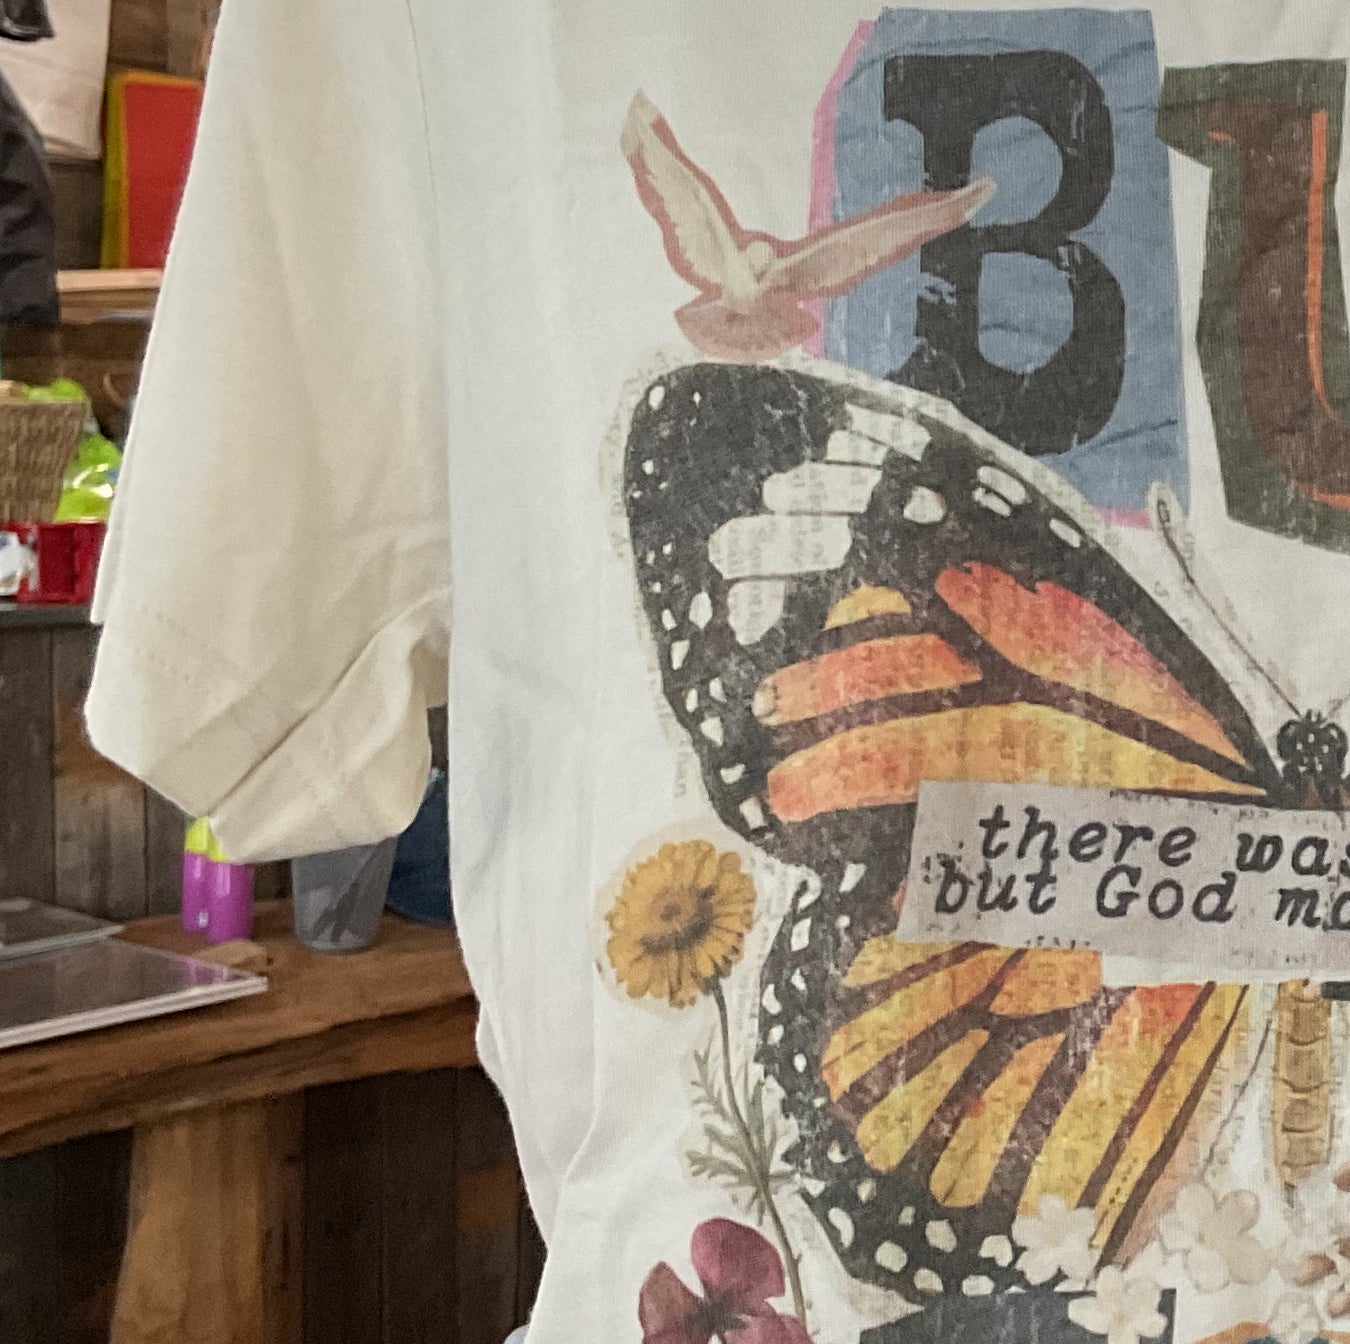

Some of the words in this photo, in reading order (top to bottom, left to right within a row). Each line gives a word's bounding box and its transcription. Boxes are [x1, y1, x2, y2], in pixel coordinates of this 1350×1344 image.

[978, 804, 1198, 867] there
[935, 855, 1057, 915] but
[1096, 864, 1238, 924] God
